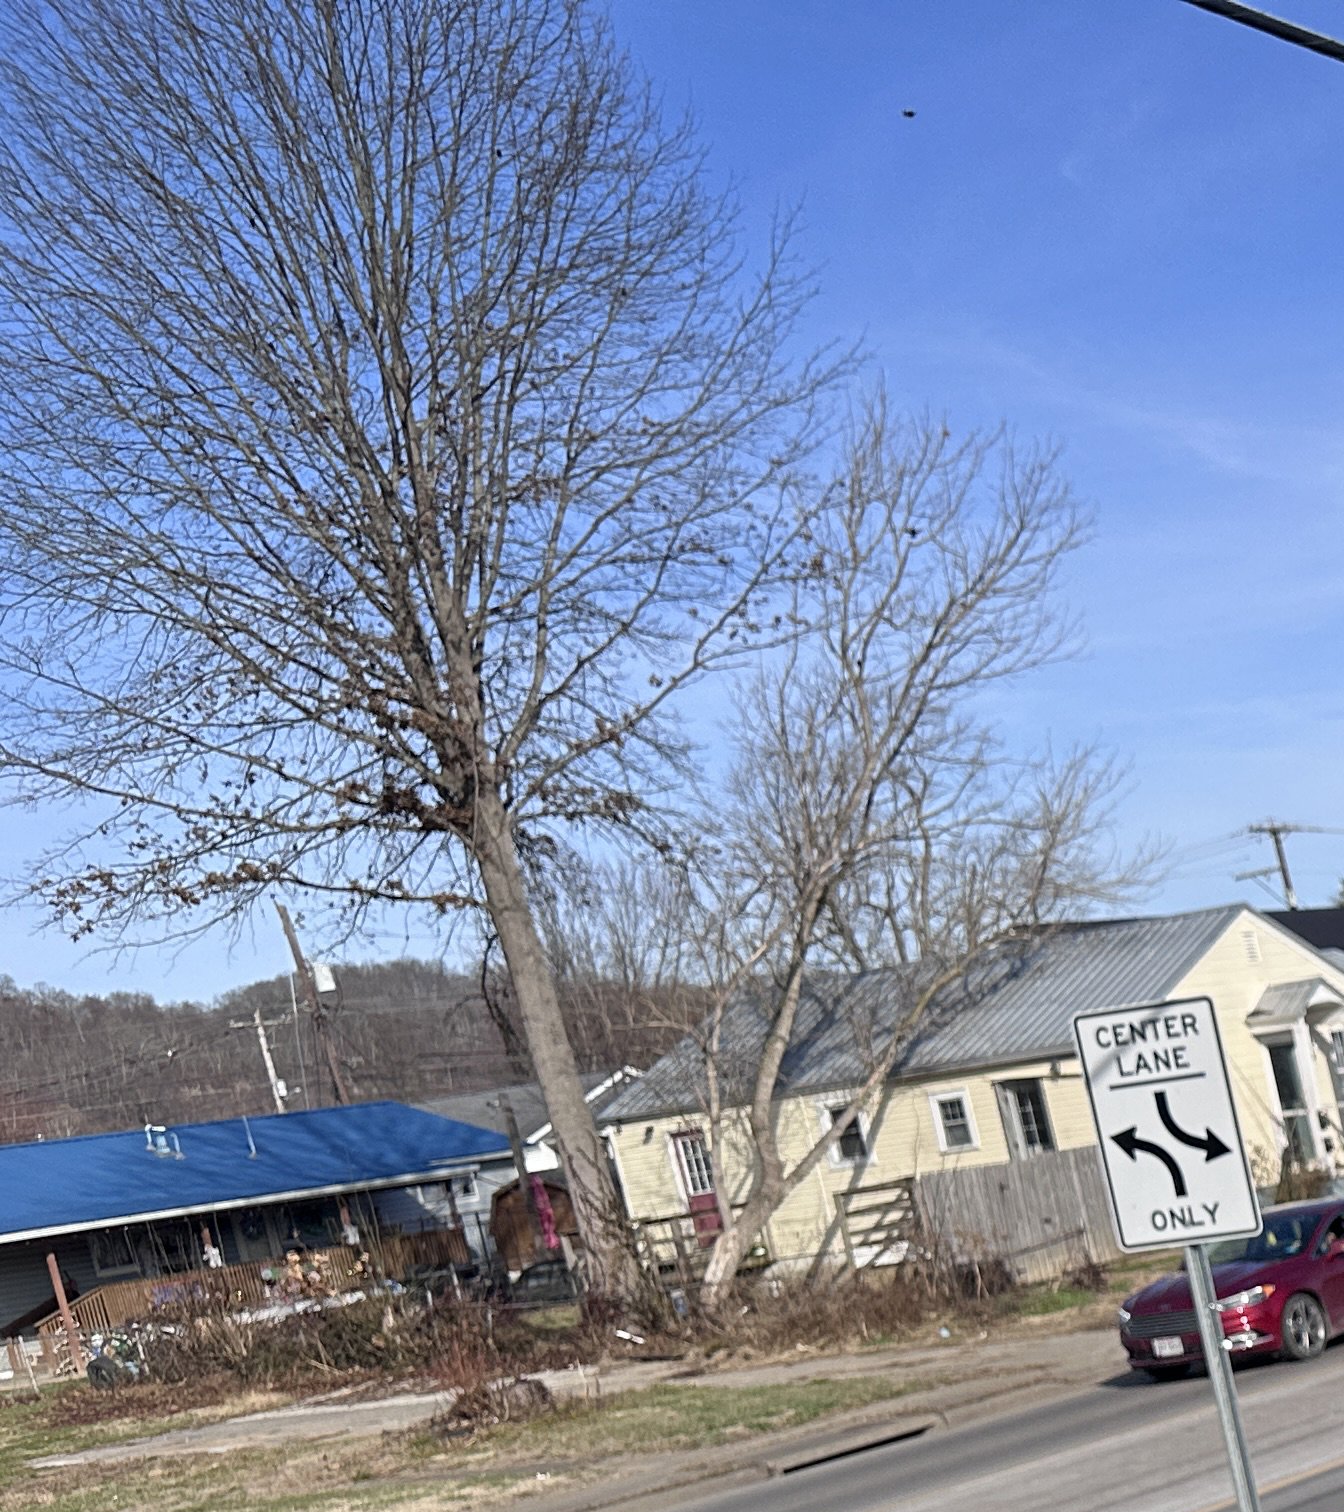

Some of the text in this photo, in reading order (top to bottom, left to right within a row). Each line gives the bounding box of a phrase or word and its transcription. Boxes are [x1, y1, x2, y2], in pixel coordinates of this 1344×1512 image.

[1095, 1013, 1199, 1049] CENTER
[1117, 1046, 1191, 1077] LANE
[1151, 1203, 1220, 1231] ONLY
